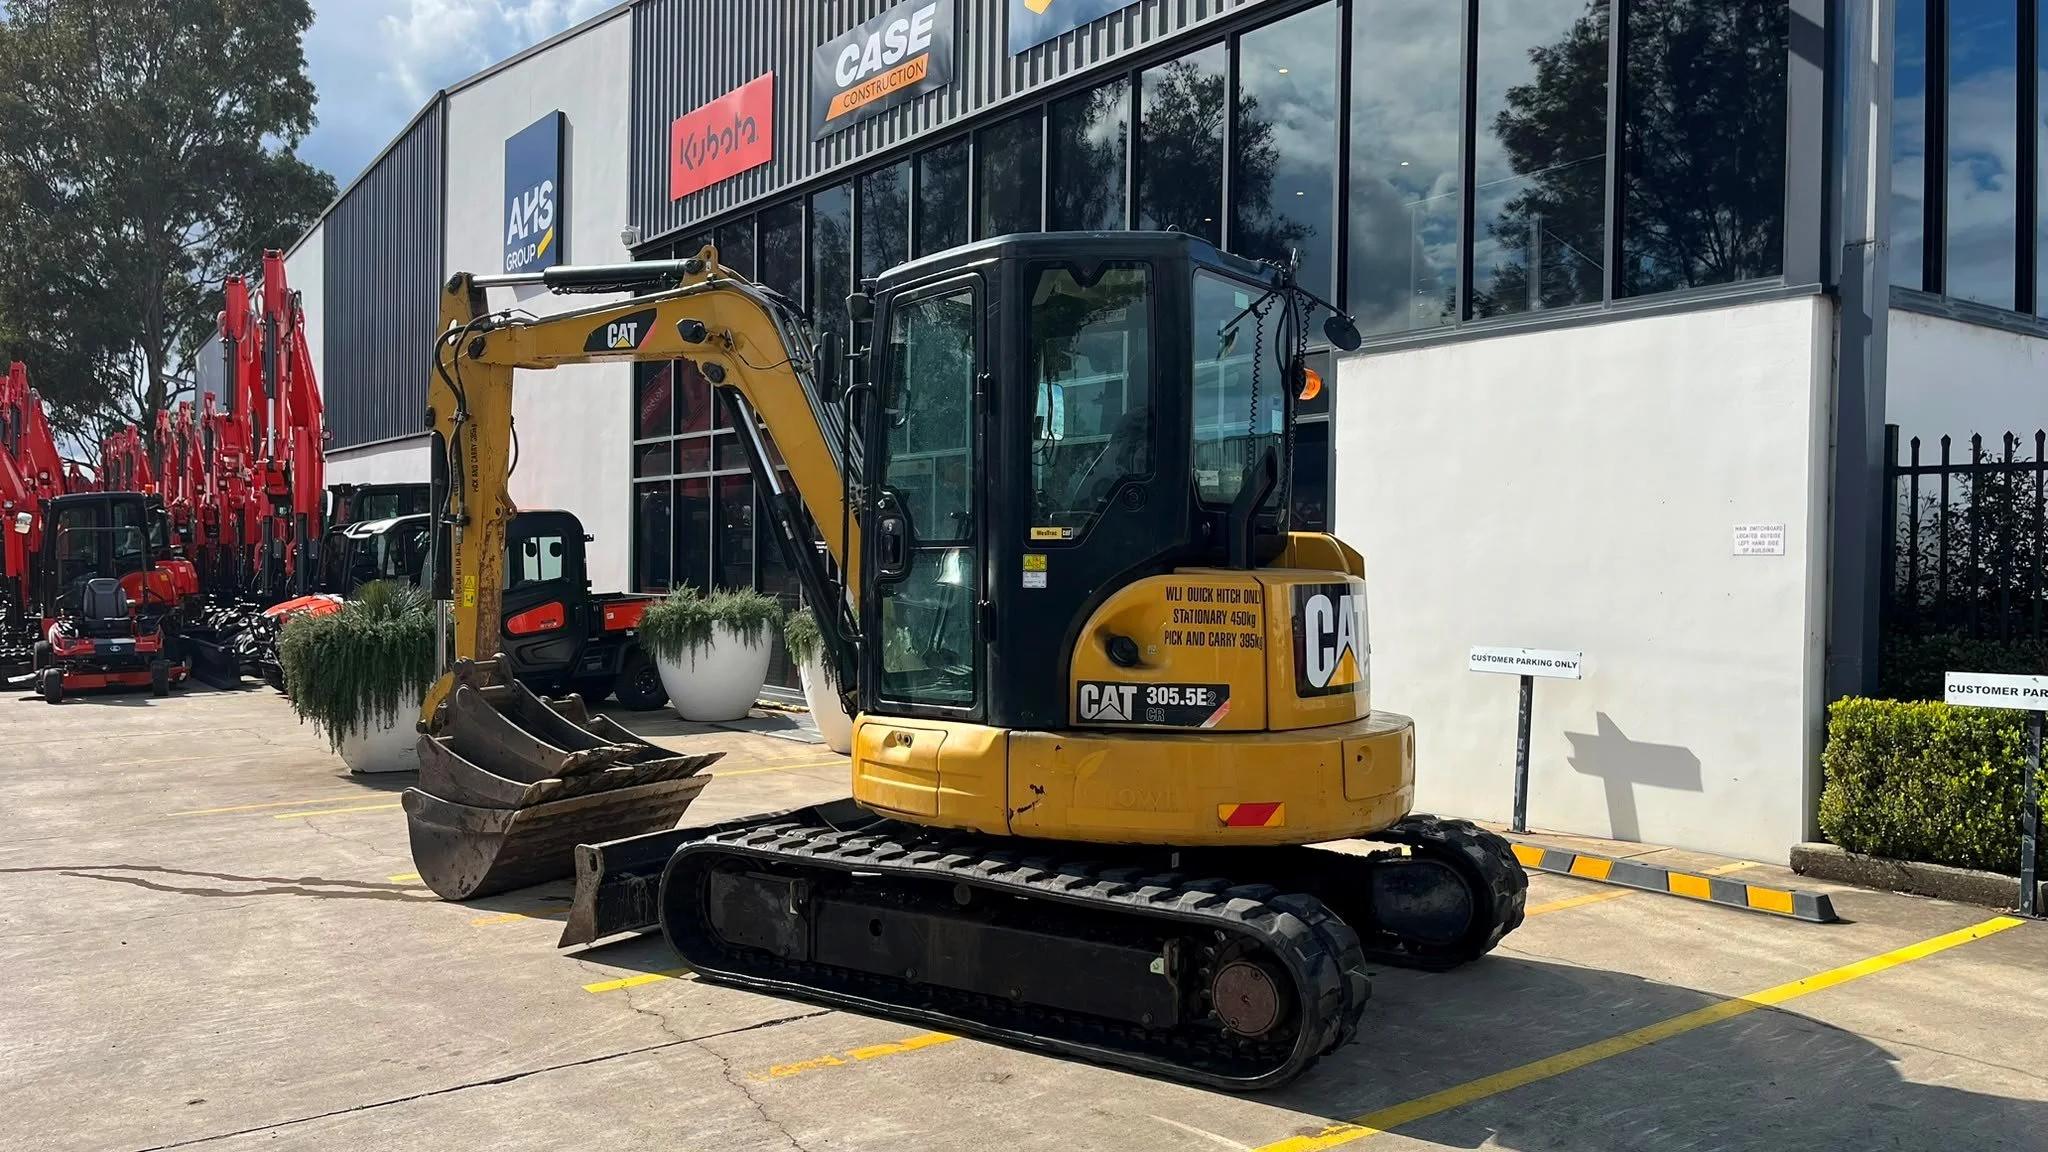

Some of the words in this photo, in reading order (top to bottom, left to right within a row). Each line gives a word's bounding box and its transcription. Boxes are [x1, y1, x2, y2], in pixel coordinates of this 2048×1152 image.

[835, 2, 936, 87] CASE
[843, 62, 924, 107] CONSTRUCTION
[680, 112, 758, 171] Kubota
[507, 180, 553, 246] AHS
[506, 243, 536, 271] GROUP
[607, 322, 637, 349] CAT
[1166, 586, 1183, 601] WLI
[1216, 588, 1241, 604] HITCH
[1173, 608, 1227, 625] STATIONARY
[1230, 611, 1256, 629] 450kg
[1164, 630, 1183, 646] PICK
[1186, 631, 1206, 647] AND
[1208, 632, 1237, 647] CARRY
[1240, 632, 1263, 651] 395kg
[1305, 594, 1367, 689] CAT
[1471, 653, 1514, 664] CUSTOMER
[1516, 657, 1553, 668] PARKING
[1554, 660, 1578, 669] ONLY
[1080, 684, 1138, 721] CAT
[1146, 686, 1217, 706] 305.5E2
[1948, 684, 2019, 697] CUSTOMER
[2023, 687, 2048, 698] PAR
[1146, 708, 1165, 722] CR
